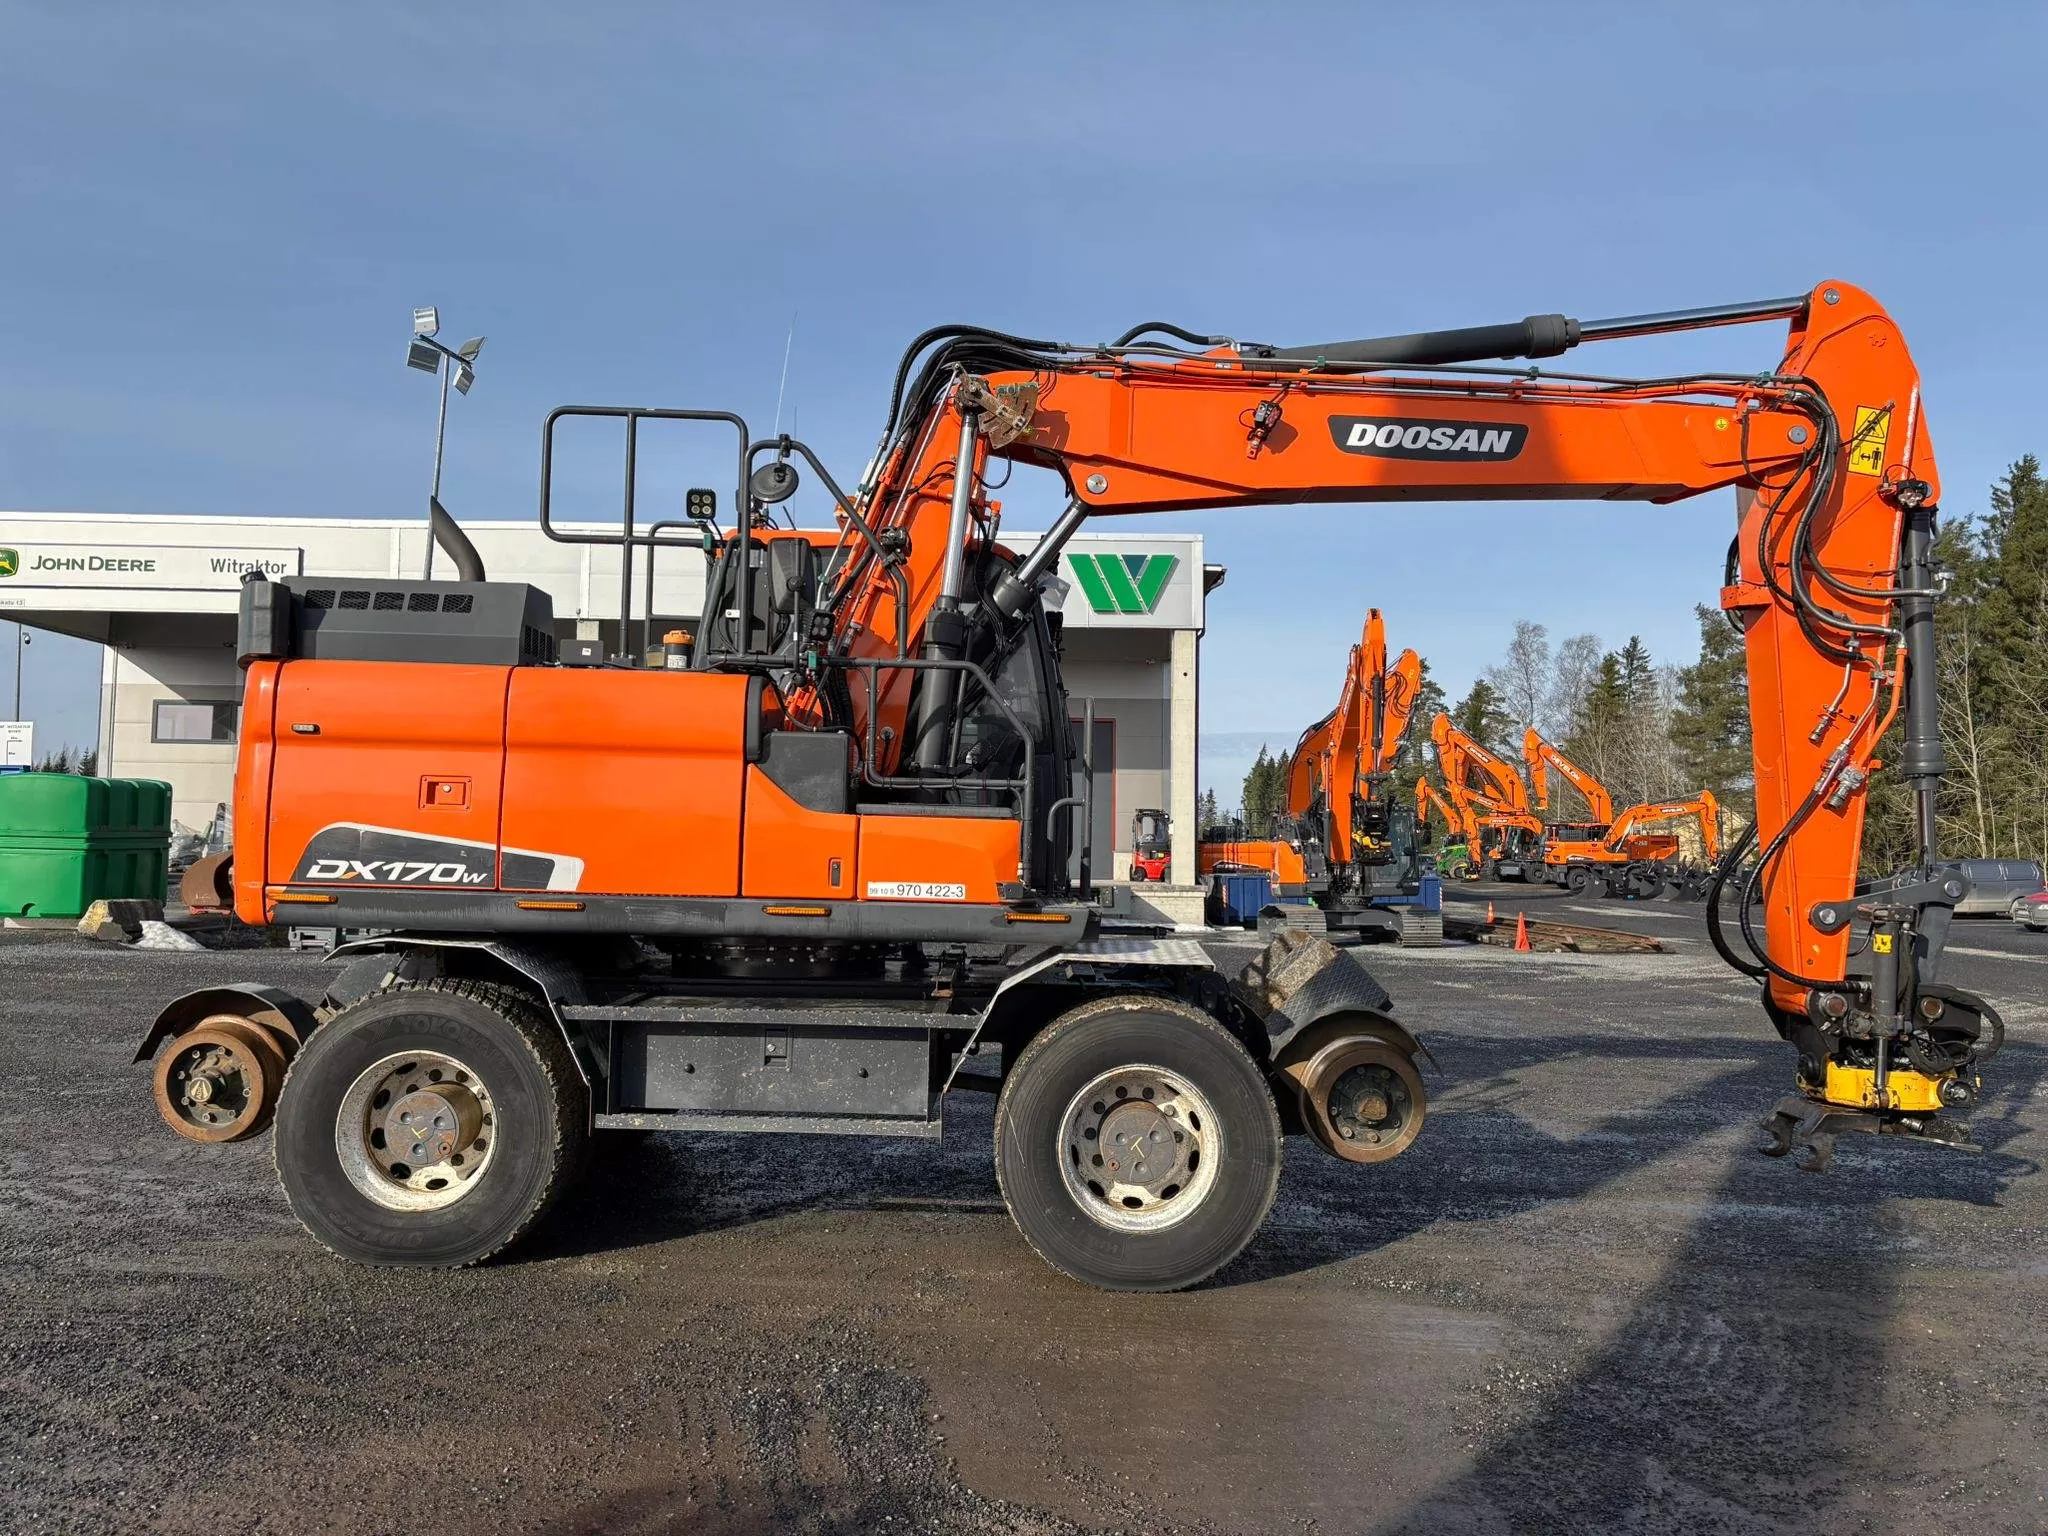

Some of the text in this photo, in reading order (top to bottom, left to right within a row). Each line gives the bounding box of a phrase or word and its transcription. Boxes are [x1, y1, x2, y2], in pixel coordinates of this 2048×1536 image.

[1345, 423, 1512, 453] DOOSAN
[30, 555, 156, 572] JOHN DEERE
[210, 558, 287, 574] Witraktor
[1551, 755, 1580, 780] DEVELON
[896, 884, 921, 897] 970
[925, 885, 964, 898] 422-3
